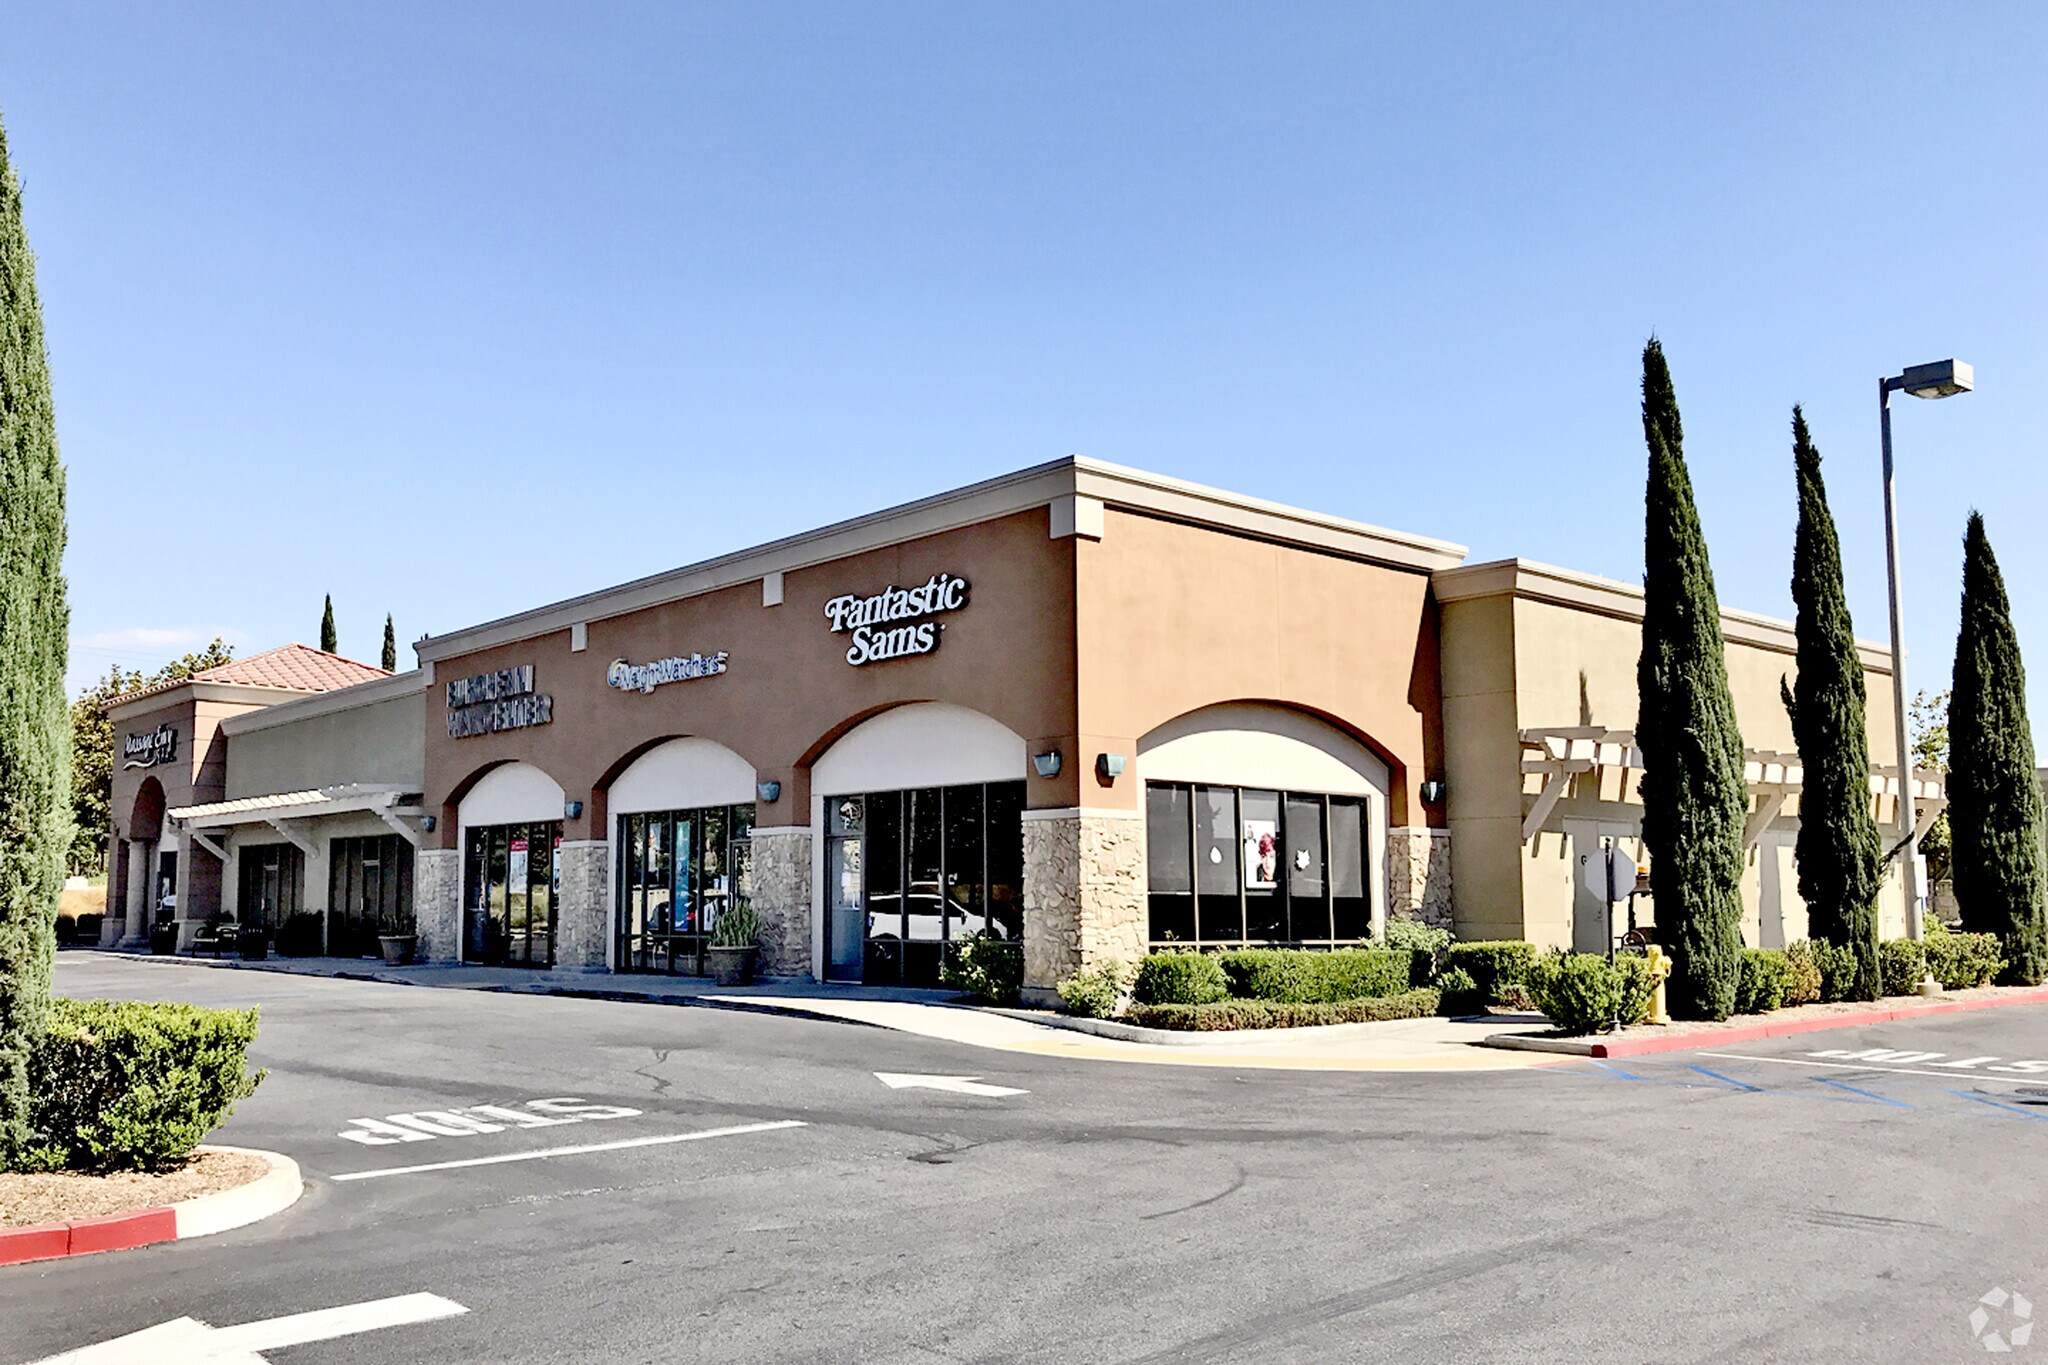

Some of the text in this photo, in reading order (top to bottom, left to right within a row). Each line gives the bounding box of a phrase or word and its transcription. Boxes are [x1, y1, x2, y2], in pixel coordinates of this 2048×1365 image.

[824, 573, 966, 633] Fantastic
[846, 622, 936, 666] Sams
[1804, 1048, 2048, 1073] STOP
[337, 1098, 643, 1145] STOP
